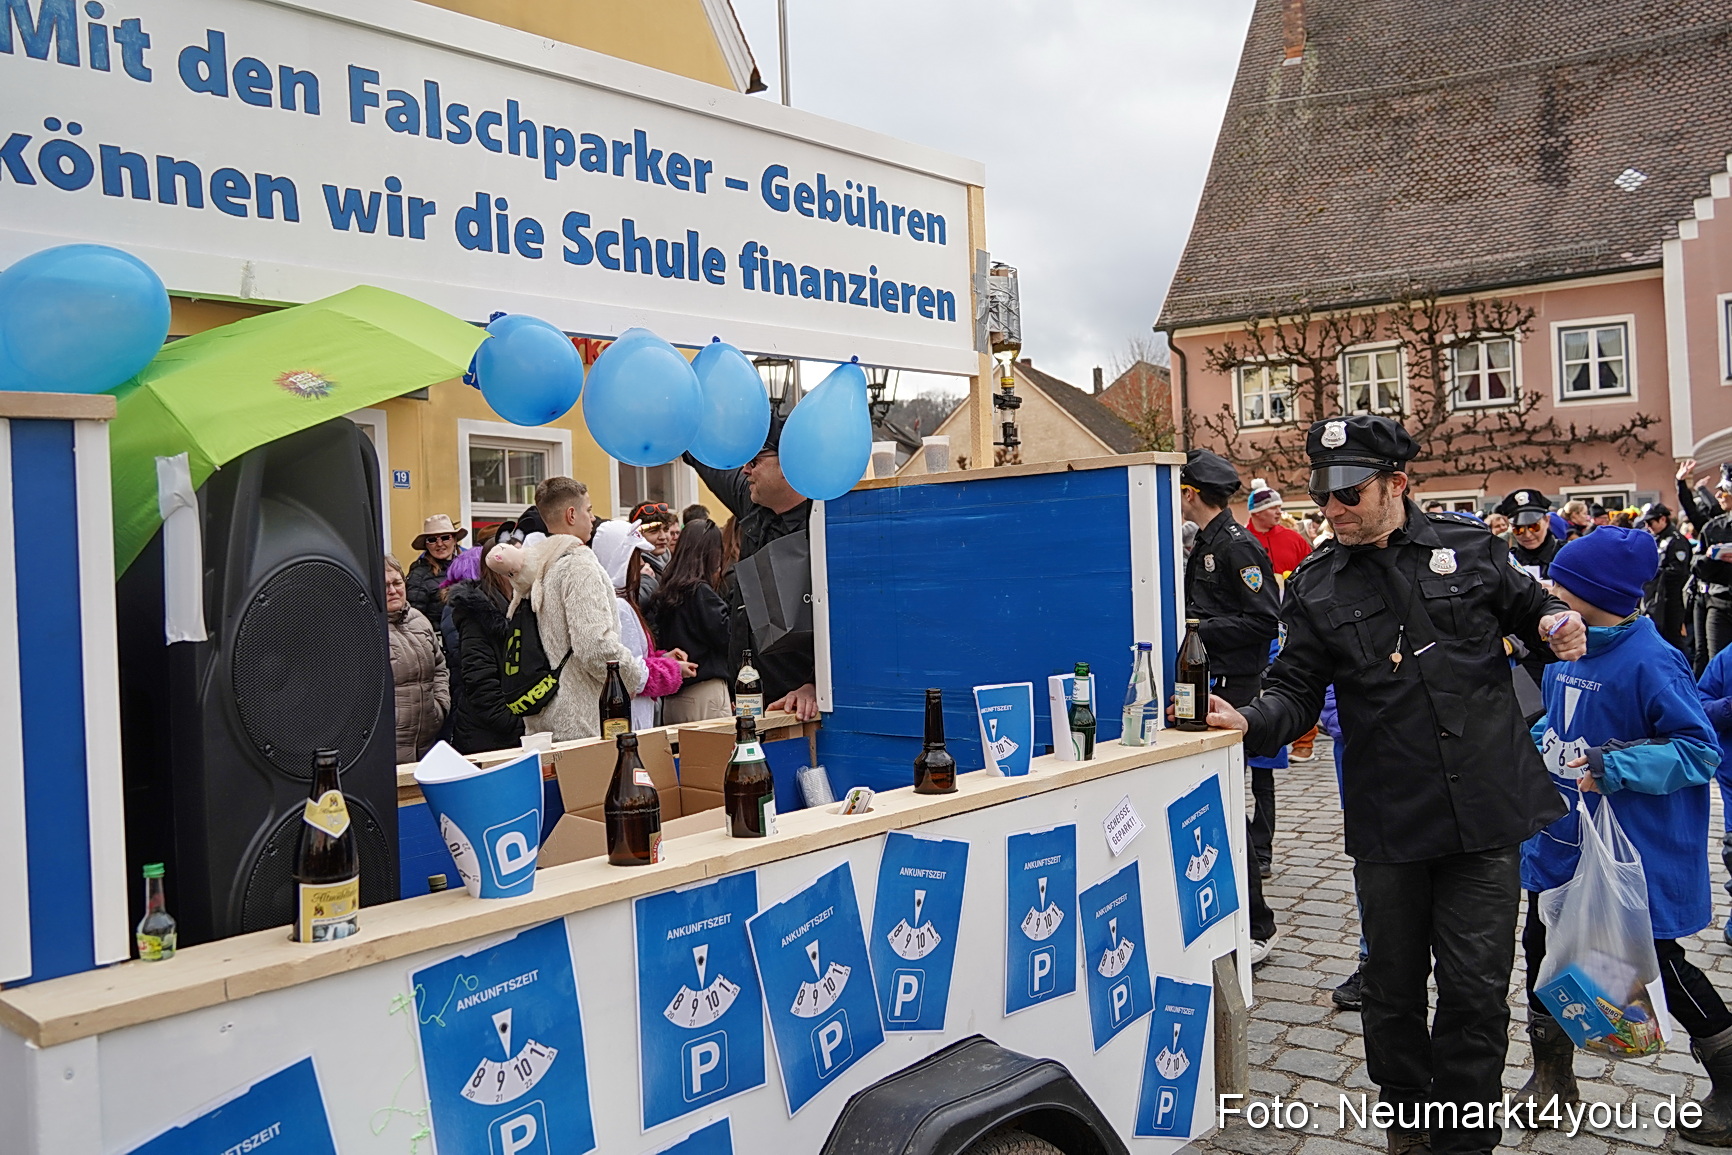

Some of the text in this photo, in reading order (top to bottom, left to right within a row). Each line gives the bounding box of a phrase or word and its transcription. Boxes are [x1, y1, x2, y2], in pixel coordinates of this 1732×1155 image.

[0, 0, 152, 83] Mit
[178, 29, 321, 116] den
[347, 64, 713, 194] Falschparker
[760, 164, 947, 246] Gebühren
[0, 117, 957, 323] können wir die Schule finanzieren
[395, 471, 406, 483] 19
[506, 674, 557, 715] RTYSIX
[1555, 672, 1602, 692] ANKUNFTSZEIT
[995, 743, 1005, 755] 10
[1558, 749, 1566, 767] 6
[1106, 804, 1130, 833] SCHEISSE
[1111, 816, 1137, 845] GEPARKT!
[1181, 803, 1210, 829] ANKUNFTSZEIT
[449, 842, 464, 860] 10
[495, 831, 538, 876] P
[1023, 855, 1062, 871] ANKUNFTSZEIT
[899, 867, 947, 880] ANKUNFTSZEIT
[1095, 892, 1128, 919] ANKUNFTSZEIT
[1199, 886, 1214, 922] P
[666, 913, 732, 941] ANKUNFTSZEIT
[781, 905, 834, 948] ANKUNFTSZEIT
[1026, 912, 1033, 925] 8
[1035, 917, 1041, 932] 9
[1044, 913, 1053, 929] 10
[893, 924, 903, 938] 8
[904, 933, 912, 949] 9
[915, 932, 926, 950] 10
[1033, 952, 1051, 992] P
[456, 969, 539, 1012] ANKUNFTSZEIT
[672, 992, 685, 1011] 8
[691, 998, 699, 1018] 9
[705, 990, 720, 1012] 10
[796, 989, 806, 1006] 8
[812, 988, 819, 1006] 9
[823, 976, 836, 996] 10
[894, 974, 919, 1017] P
[1112, 984, 1128, 1023] P
[1558, 988, 1570, 1003] P
[667, 1010, 675, 1020] 20
[689, 1019, 696, 1027] 21
[712, 1009, 720, 1019] 22
[1164, 1004, 1196, 1016] ANKUNFTSZEIT
[1597, 1001, 1620, 1018] HARIBO
[818, 1020, 843, 1071] P
[465, 1050, 555, 1103] 20 21 22 23
[472, 1067, 486, 1089] 8
[496, 1070, 505, 1092] 9
[514, 1057, 533, 1082] 10
[690, 1041, 720, 1095] P
[1157, 1090, 1174, 1125] P
[219, 1121, 281, 1155] FTSZEIT
[500, 1113, 537, 1155] P
